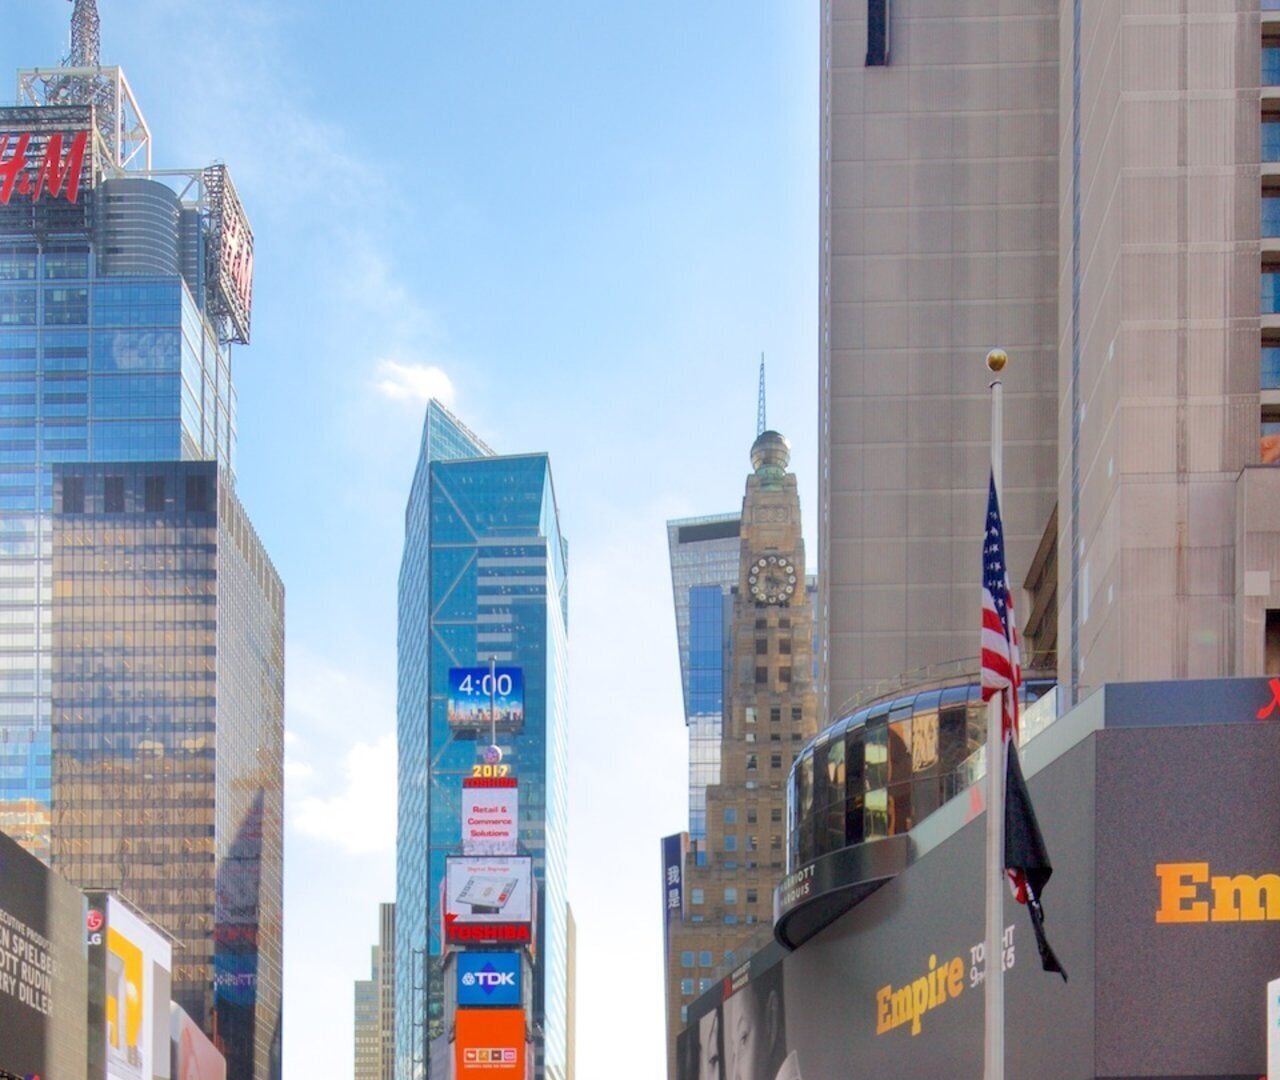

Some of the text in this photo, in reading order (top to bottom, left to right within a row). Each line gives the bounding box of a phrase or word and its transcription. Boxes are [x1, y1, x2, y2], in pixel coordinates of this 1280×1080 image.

[459, 674, 512, 696] 4:00
[472, 765, 508, 777] 2017
[448, 925, 529, 939] TOSHIBA
[971, 925, 1015, 965] TOHT
[21, 962, 52, 995] RUDIN
[474, 972, 515, 986] TDK
[19, 982, 54, 1018] DILLER
[876, 954, 964, 1035] Empire
